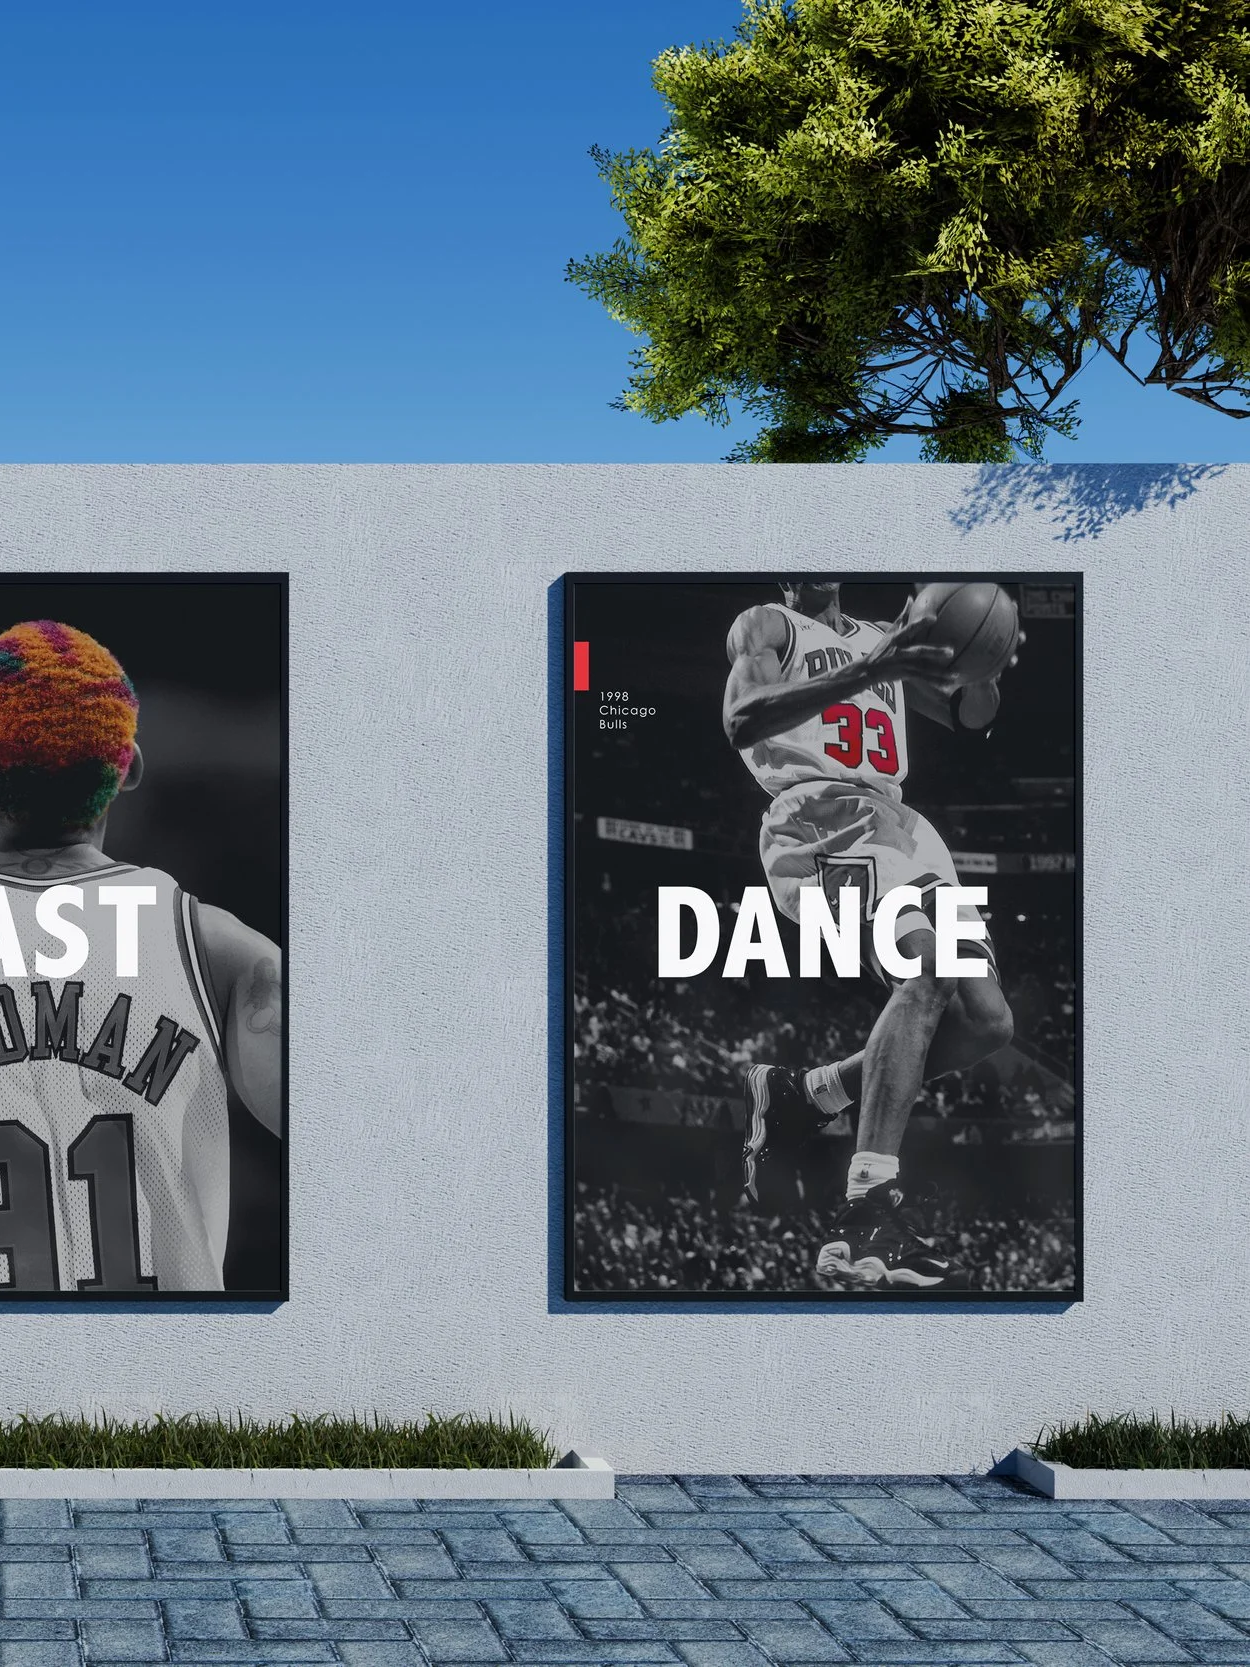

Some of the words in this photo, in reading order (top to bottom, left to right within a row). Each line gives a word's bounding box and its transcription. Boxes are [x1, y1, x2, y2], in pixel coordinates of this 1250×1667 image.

[600, 691, 629, 702] 1998
[805, 647, 897, 714] BUS
[598, 705, 656, 718] Chicago
[599, 719, 627, 730] Bulls
[821, 702, 900, 776] 33
[657, 885, 989, 979] DANCE
